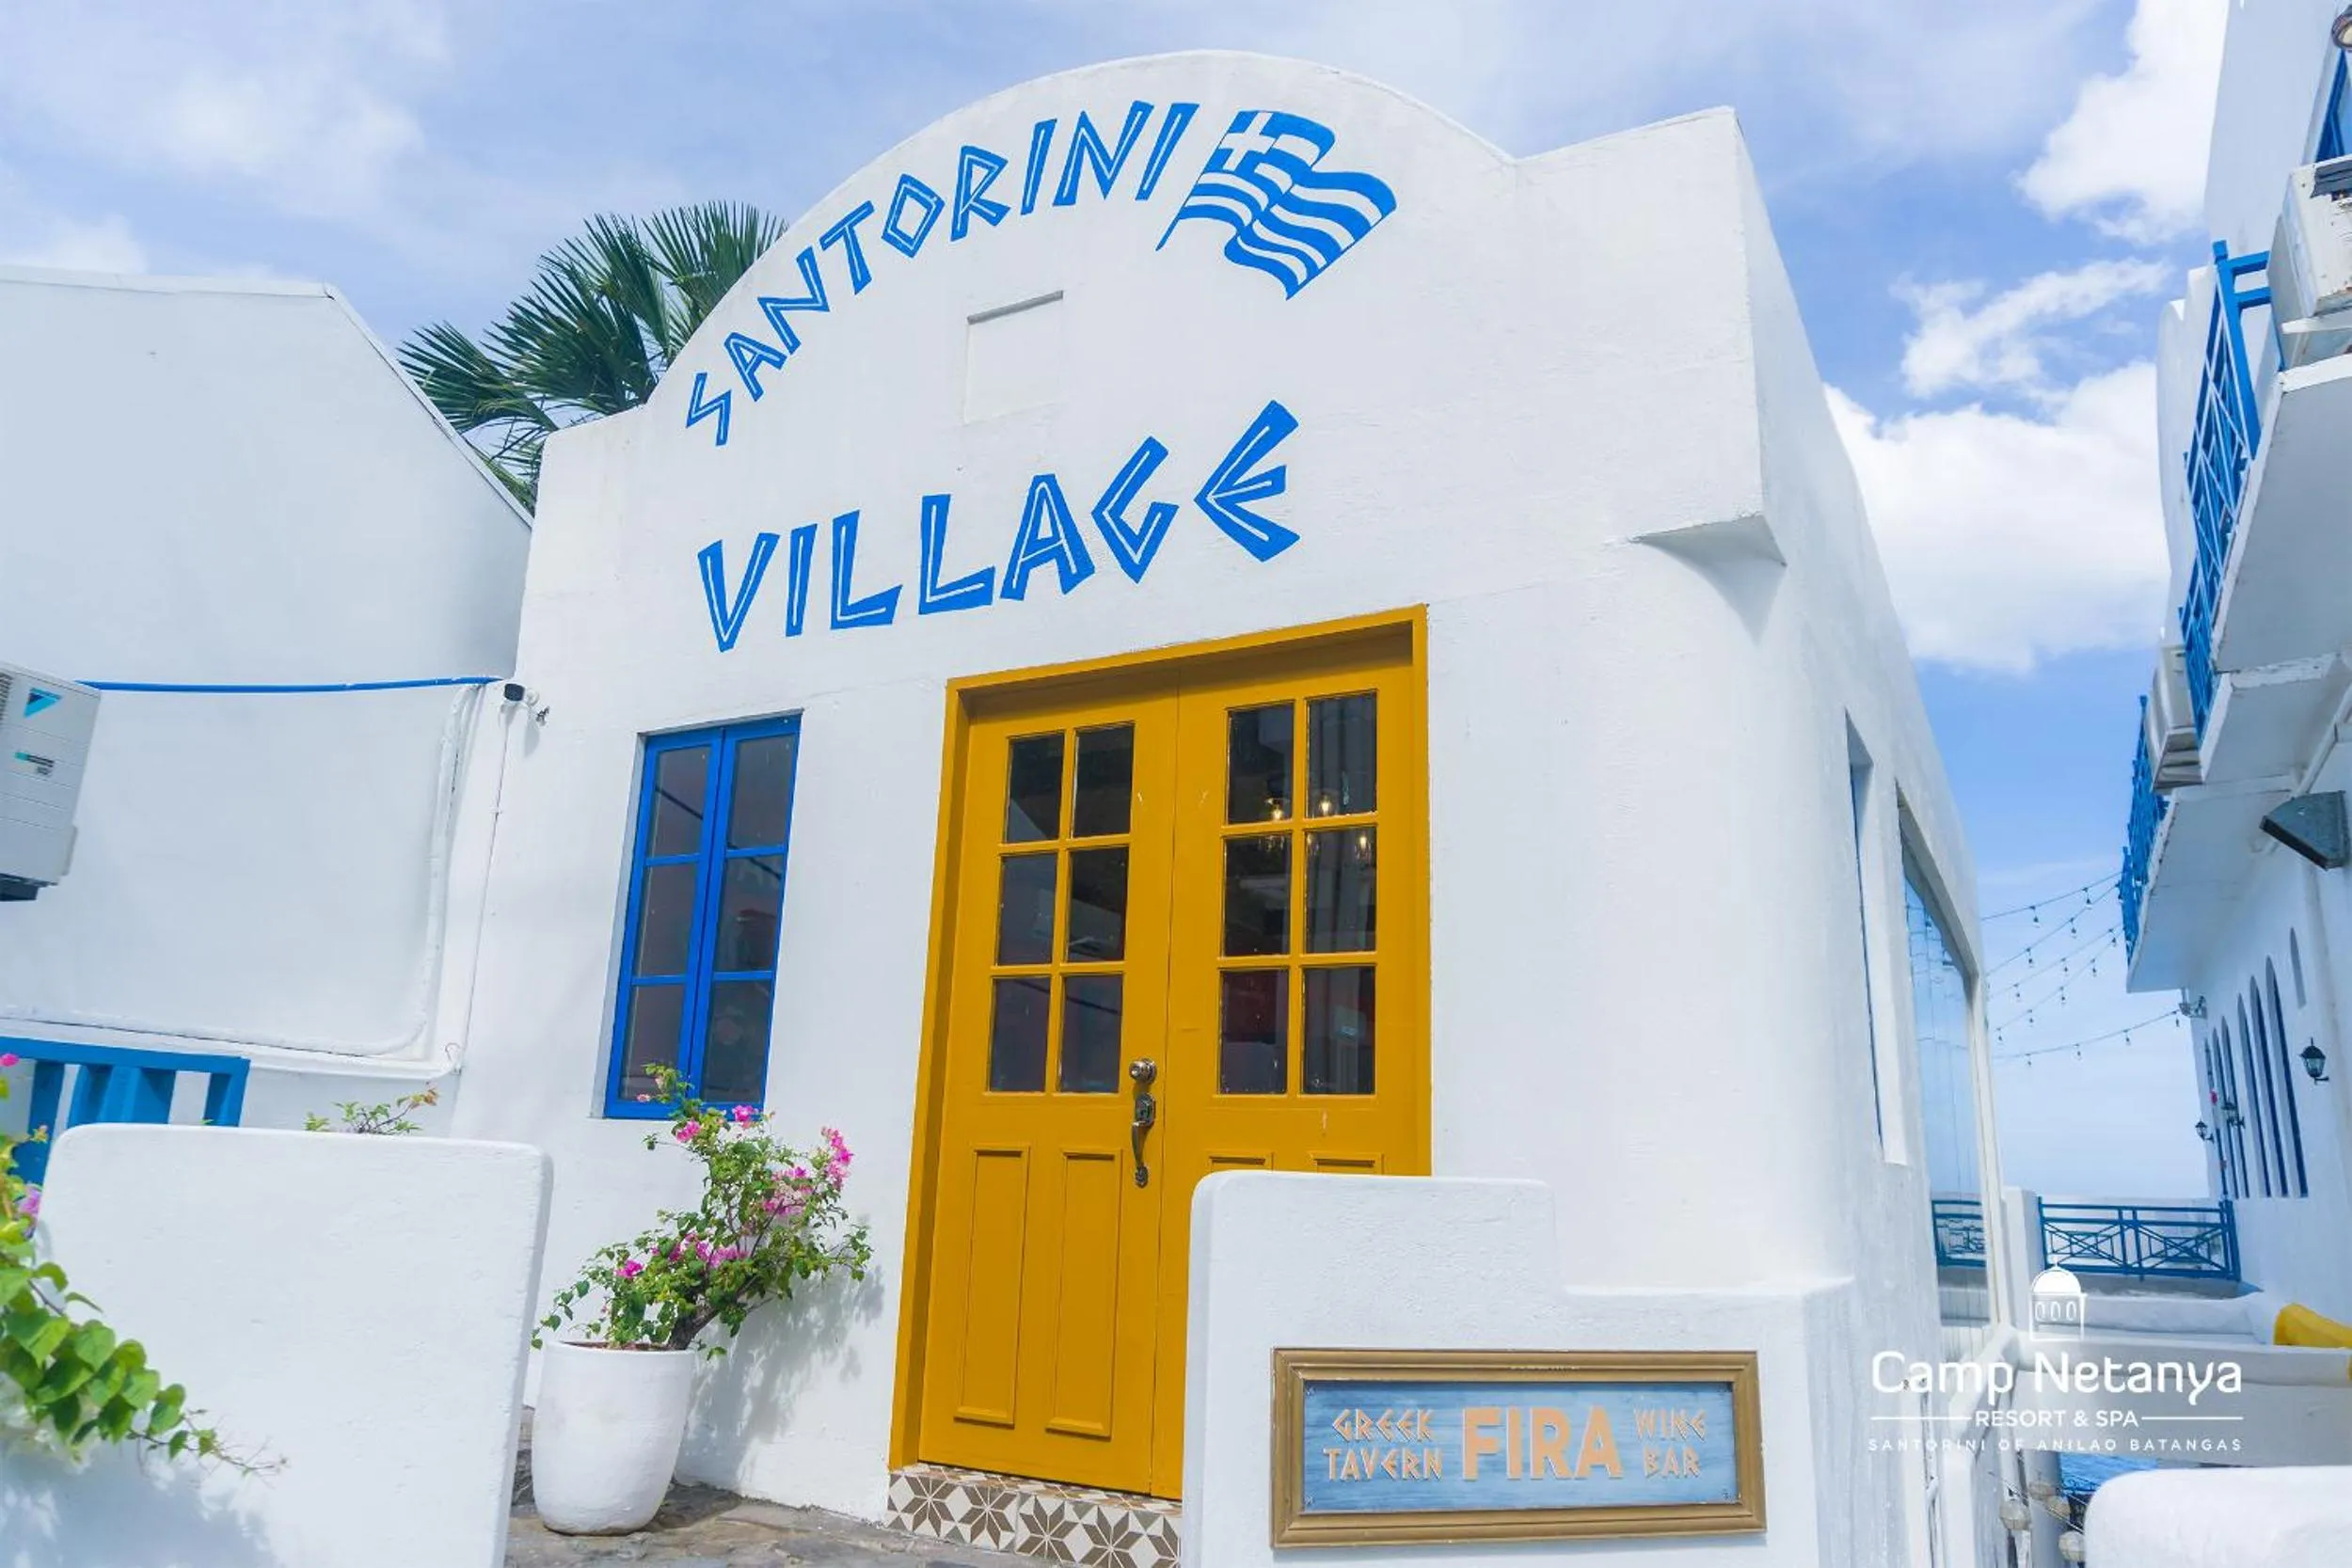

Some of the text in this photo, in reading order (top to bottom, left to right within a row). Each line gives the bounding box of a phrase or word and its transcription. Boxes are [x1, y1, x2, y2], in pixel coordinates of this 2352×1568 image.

[686, 100, 1200, 446] SANTORINI
[697, 400, 1300, 652] VILLAGE
[1331, 1408, 1435, 1442] GREEK
[1461, 1405, 1623, 1481] FIRA
[1323, 1447, 1443, 1482] TAVERN
[1644, 1446, 1702, 1479] BAR
